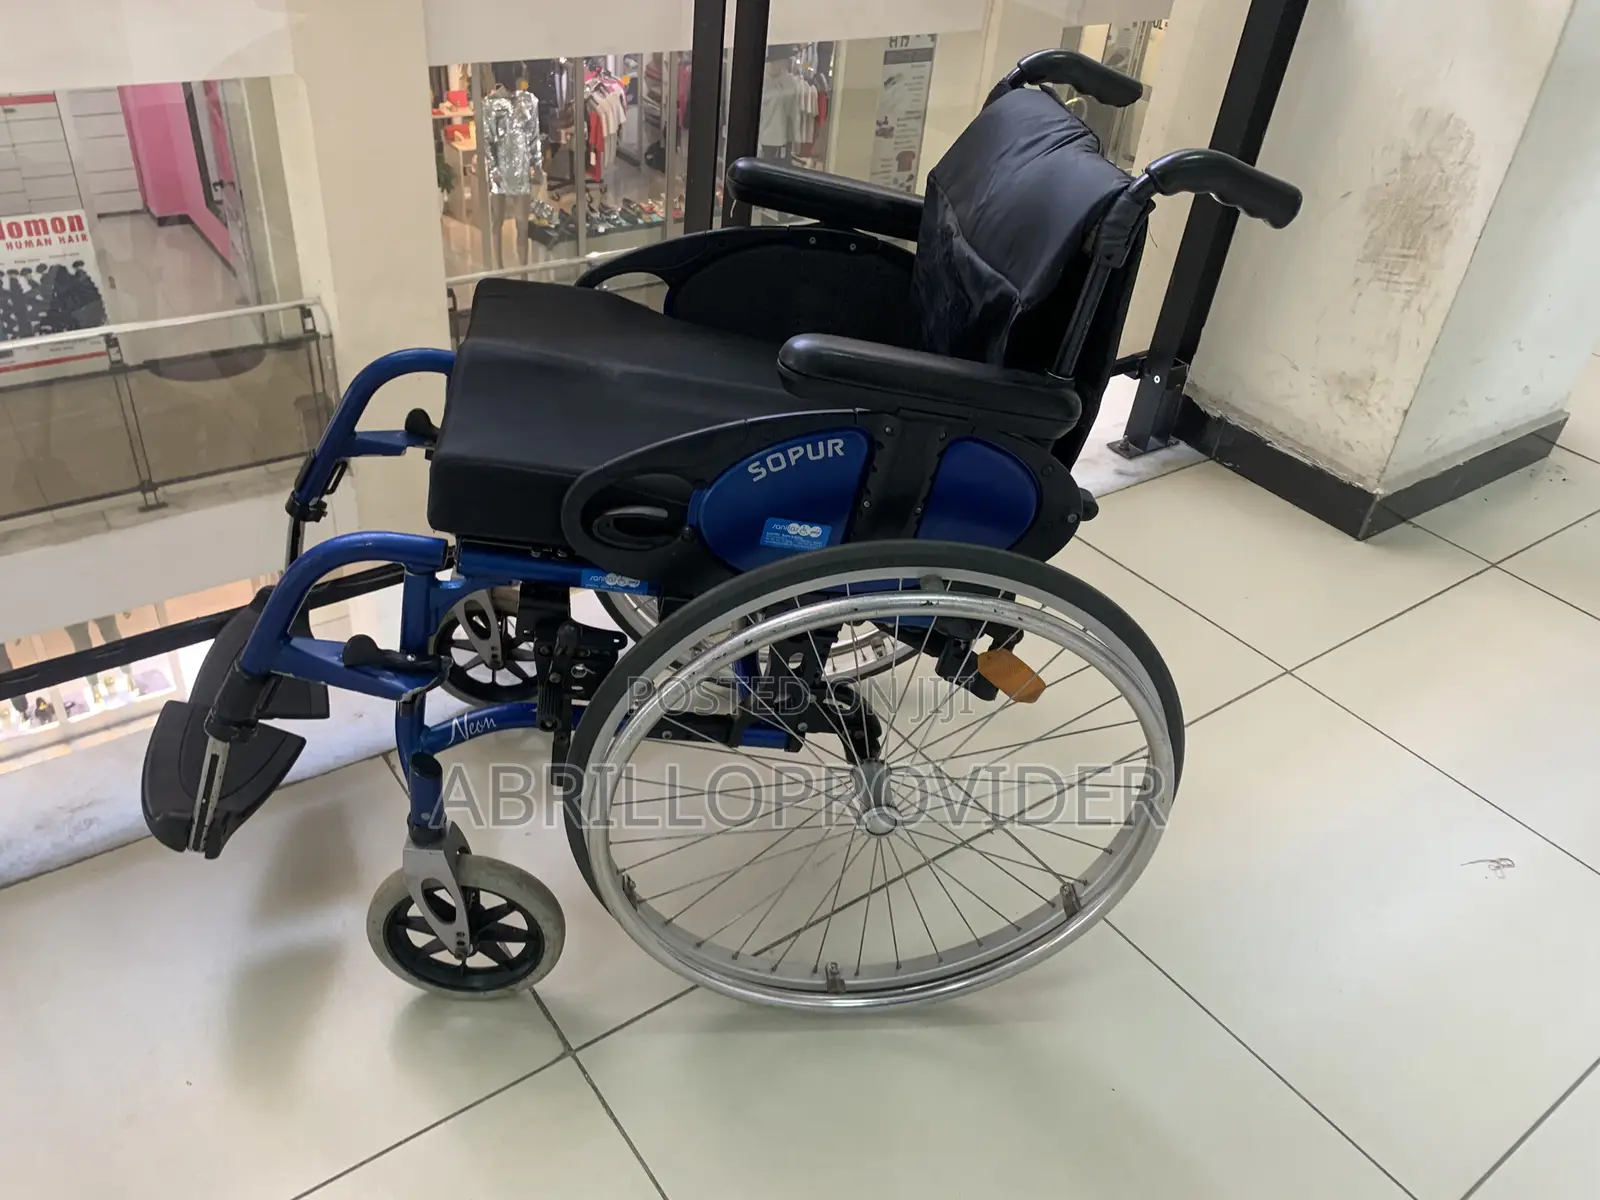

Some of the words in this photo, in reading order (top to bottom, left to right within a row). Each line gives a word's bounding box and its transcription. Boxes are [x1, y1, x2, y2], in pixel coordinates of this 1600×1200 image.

[6, 238, 52, 250] HUMAN
[59, 233, 88, 245] HAIR
[747, 438, 844, 482] SOPUR
[448, 712, 497, 746] Neon
